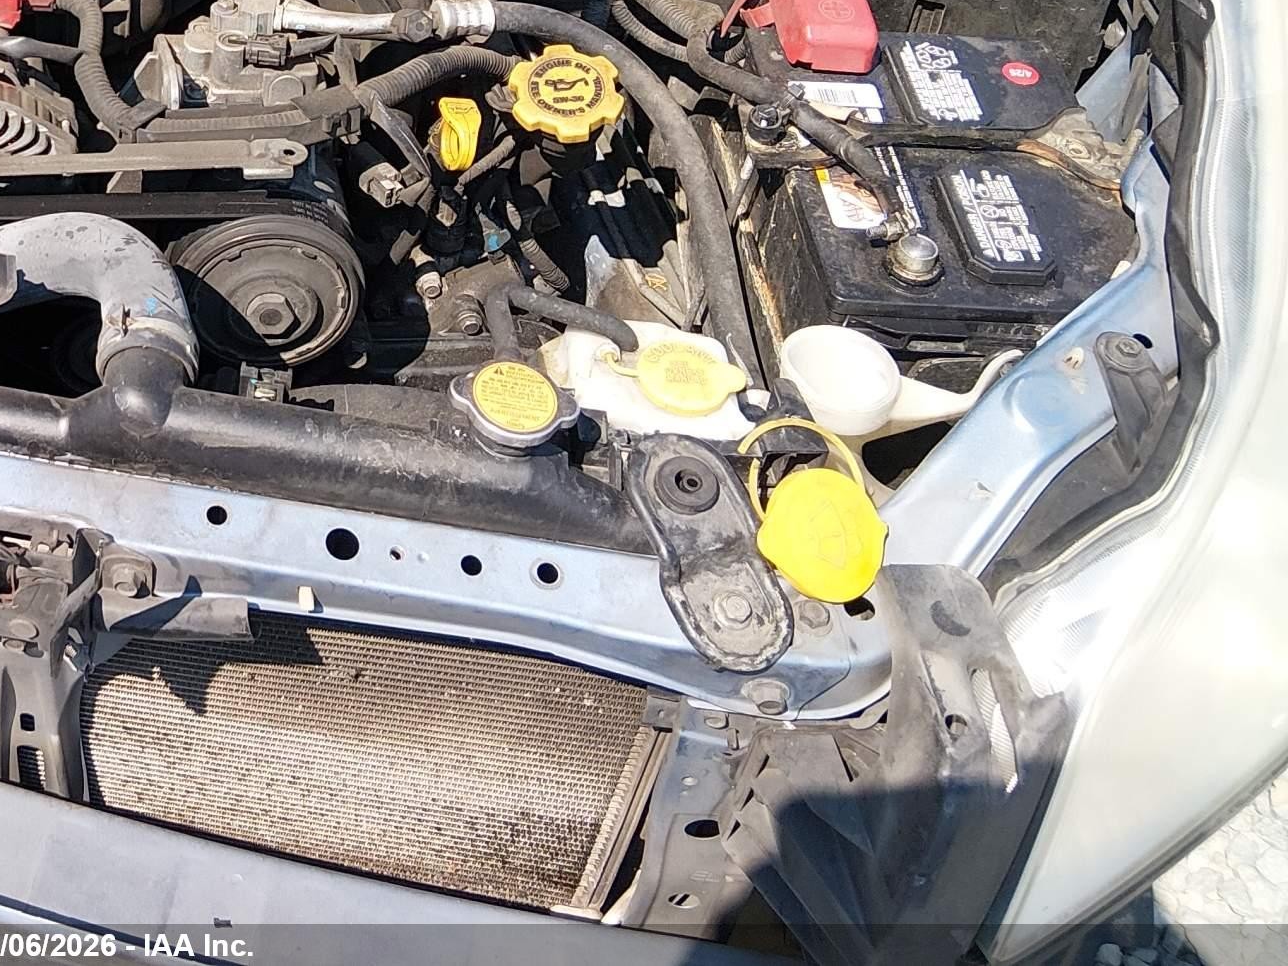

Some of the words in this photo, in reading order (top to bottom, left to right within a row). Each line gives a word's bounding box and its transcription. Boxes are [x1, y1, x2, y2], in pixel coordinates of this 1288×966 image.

[534, 59, 572, 78] ENGINE
[574, 62, 592, 75] OIL
[531, 81, 542, 99] SEE
[537, 98, 586, 118] OWNER'S
[586, 76, 603, 109] MANUAL
[967, 213, 992, 249] DANGER
